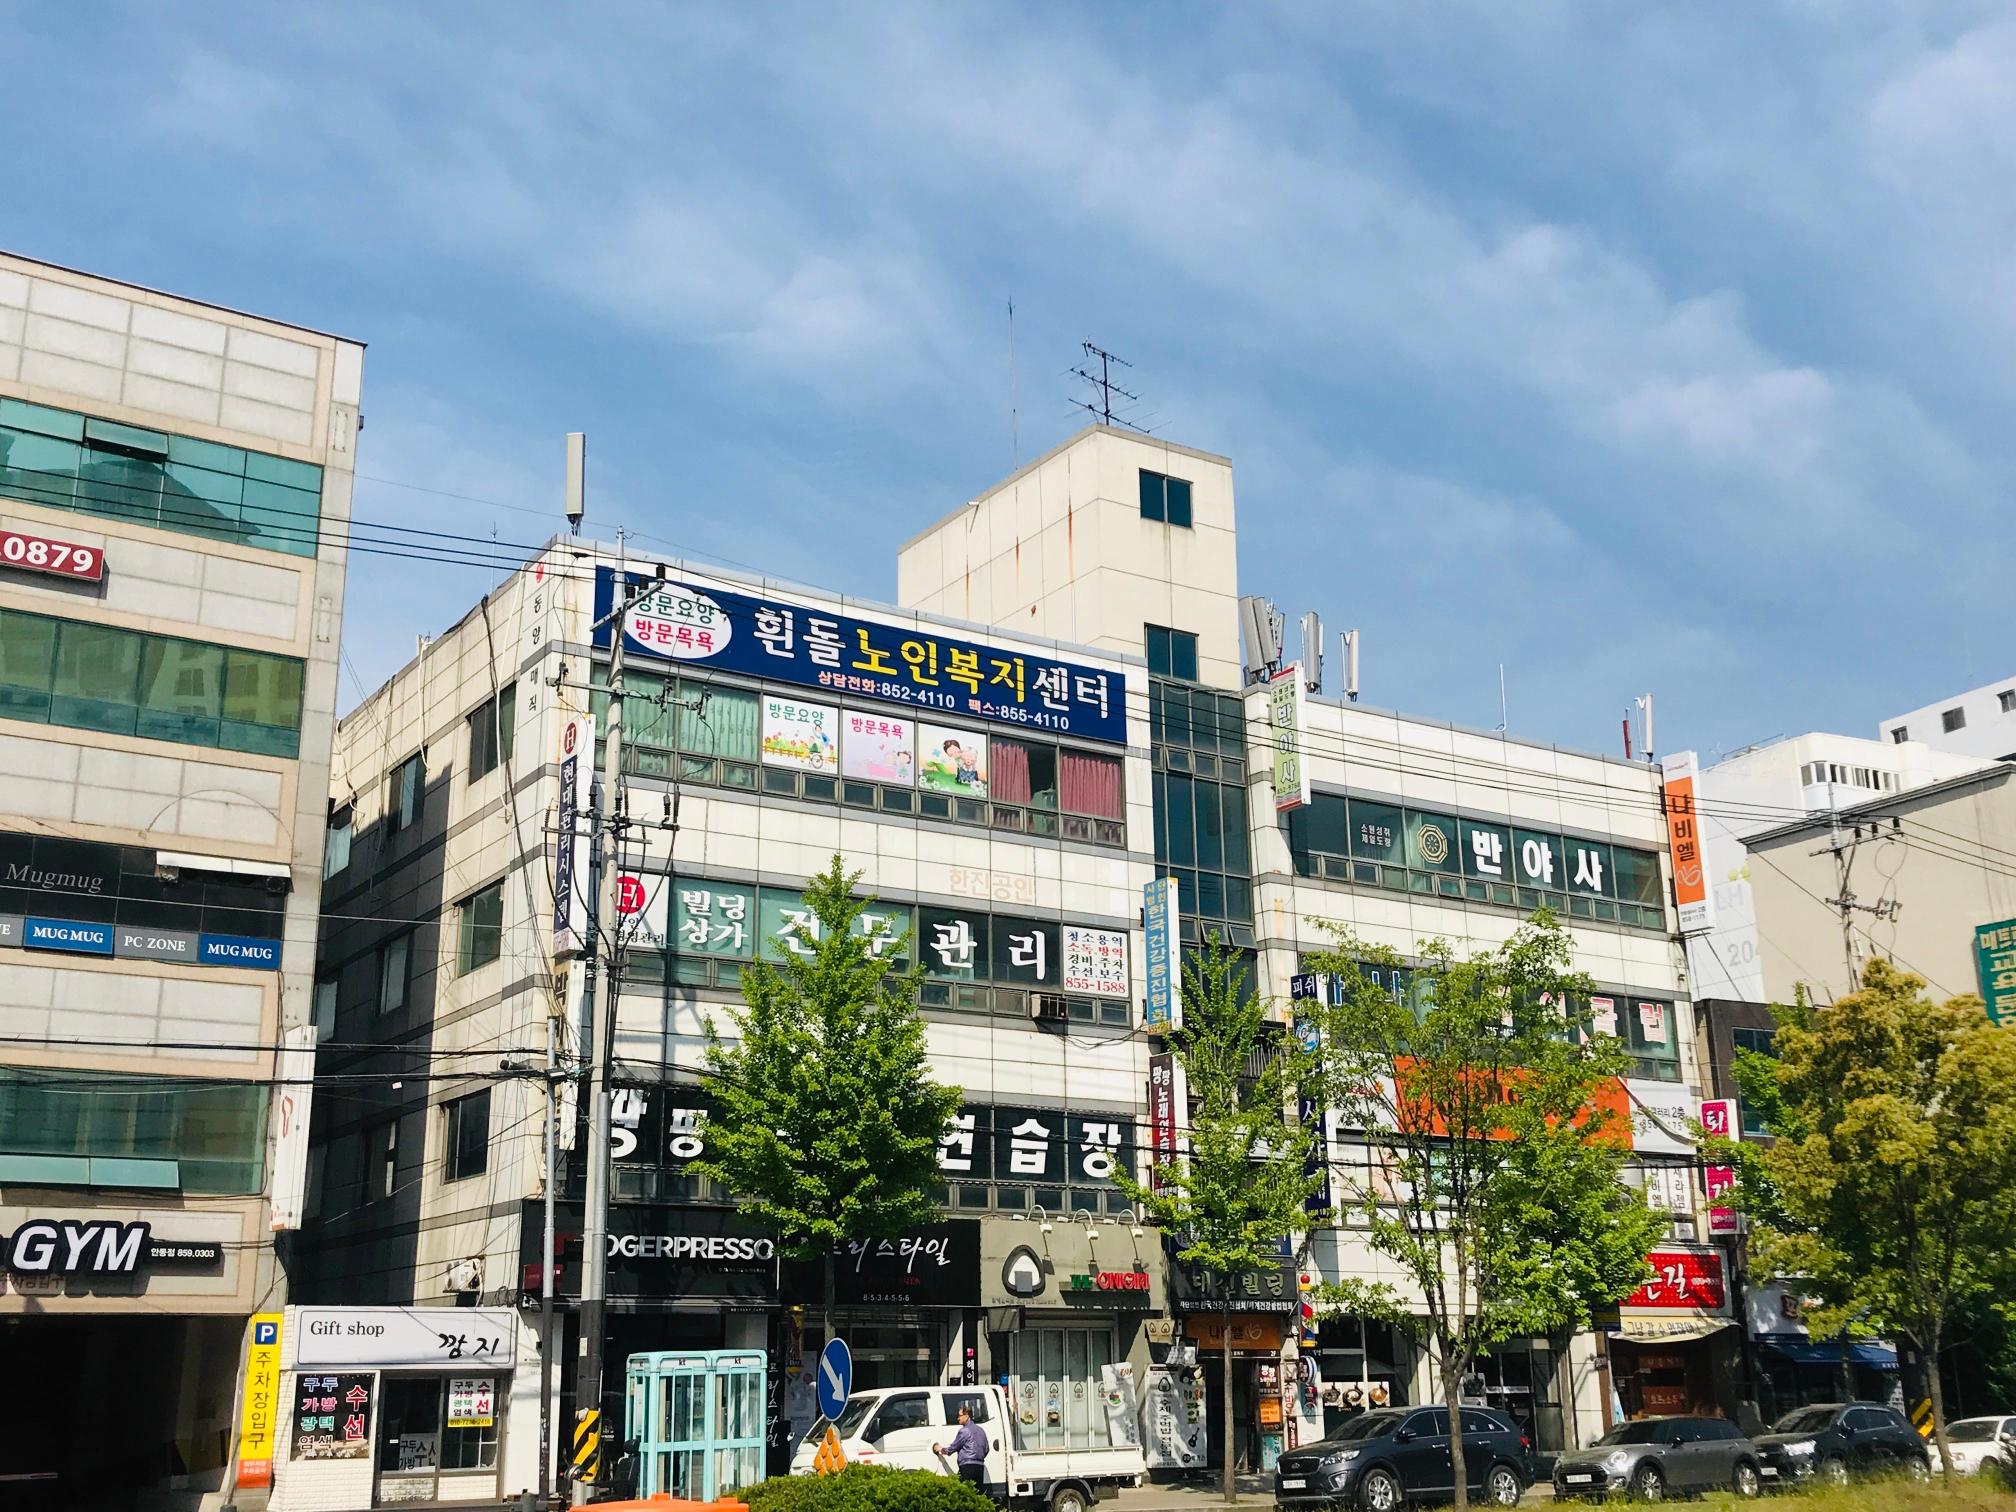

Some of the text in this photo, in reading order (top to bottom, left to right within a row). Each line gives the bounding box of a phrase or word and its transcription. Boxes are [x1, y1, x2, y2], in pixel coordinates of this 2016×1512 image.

[4, 536, 94, 572] 0879
[635, 619, 714, 652] 방문목욕
[769, 703, 825, 726] 방문요양
[851, 717, 904, 740] 방문목욕
[1277, 702, 1295, 784] 반야사
[1471, 829, 1603, 892] 반야사
[6, 863, 104, 894] Mugmug
[682, 890, 745, 919] 빌딩
[33, 926, 104, 944] MUG MUG
[124, 935, 187, 952] PC ZONE
[678, 917, 748, 949] 상가
[208, 943, 273, 960] MUG MUG
[1728, 940, 1760, 966] 20
[1065, 976, 1126, 994] 855-1588
[935, 1114, 1122, 1178] 연습장
[11, 1225, 145, 1272] GYM
[606, 1234, 775, 1261] OGERPRESSO
[310, 1320, 385, 1338] Gift shop
[303, 1376, 339, 1393] 구두
[248, 1351, 273, 1450] 주차장입구
[343, 1384, 369, 1441] 수선
[300, 1415, 336, 1432] 광택
[298, 1434, 334, 1452] 염색
